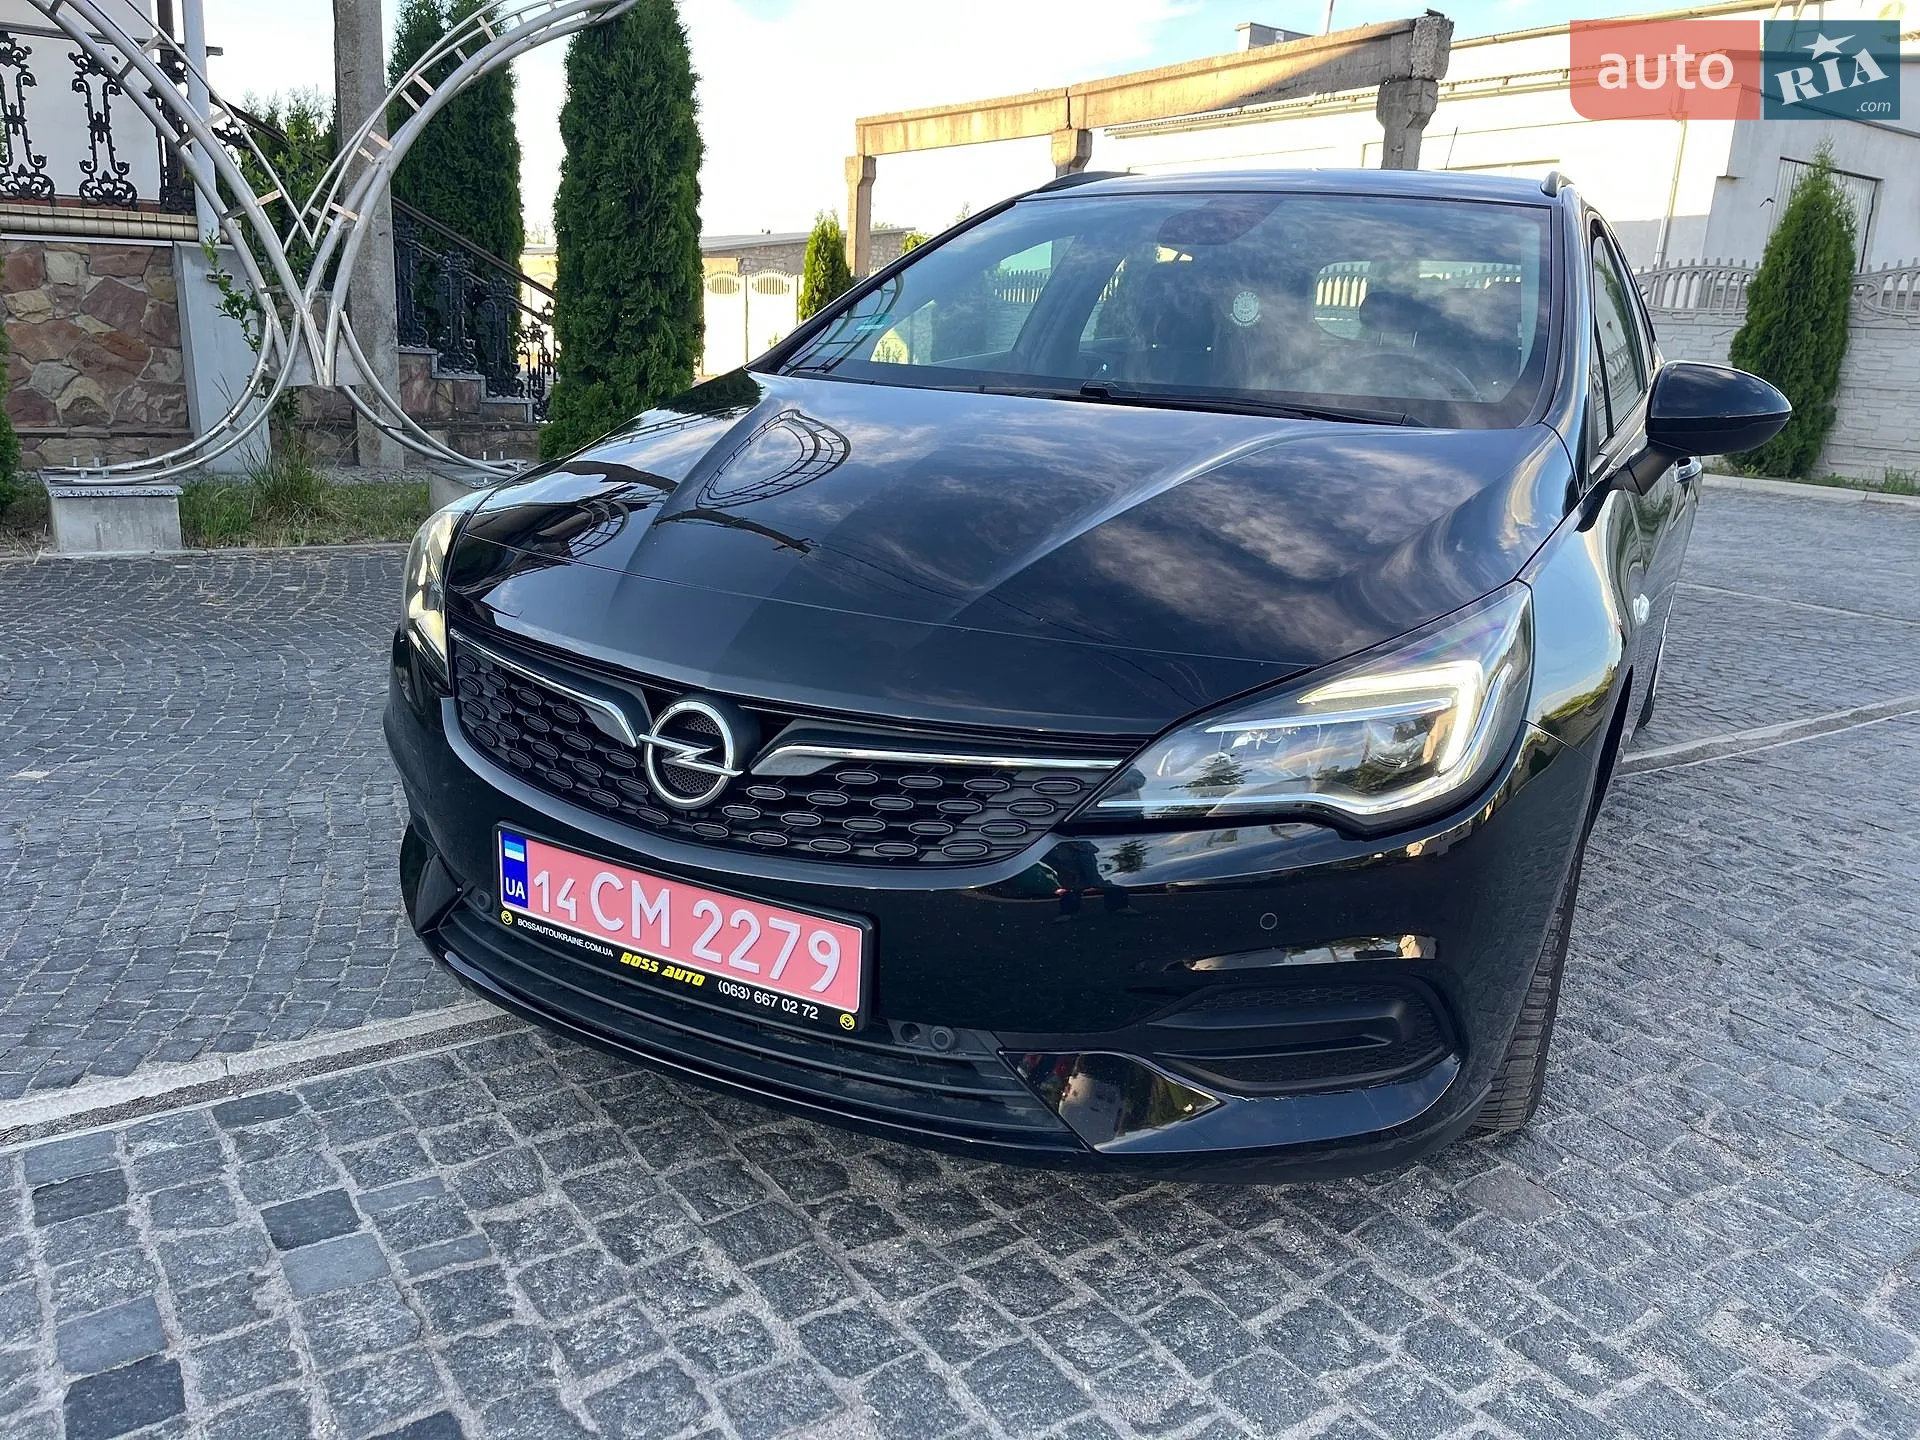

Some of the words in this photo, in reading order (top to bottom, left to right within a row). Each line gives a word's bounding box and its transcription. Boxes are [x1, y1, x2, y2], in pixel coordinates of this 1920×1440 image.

[505, 877, 526, 900] UA
[517, 917, 614, 957] BOSSAUTOUKRAINE.COM.UA
[533, 870, 577, 922] 14
[590, 872, 671, 948] CM
[692, 899, 841, 992] 2279
[620, 951, 660, 973] BOSS
[661, 965, 706, 987] AUTO
[717, 979, 751, 1000] (063)
[753, 990, 779, 1008] 667
[781, 998, 799, 1015] 02
[801, 1003, 819, 1020] 72
